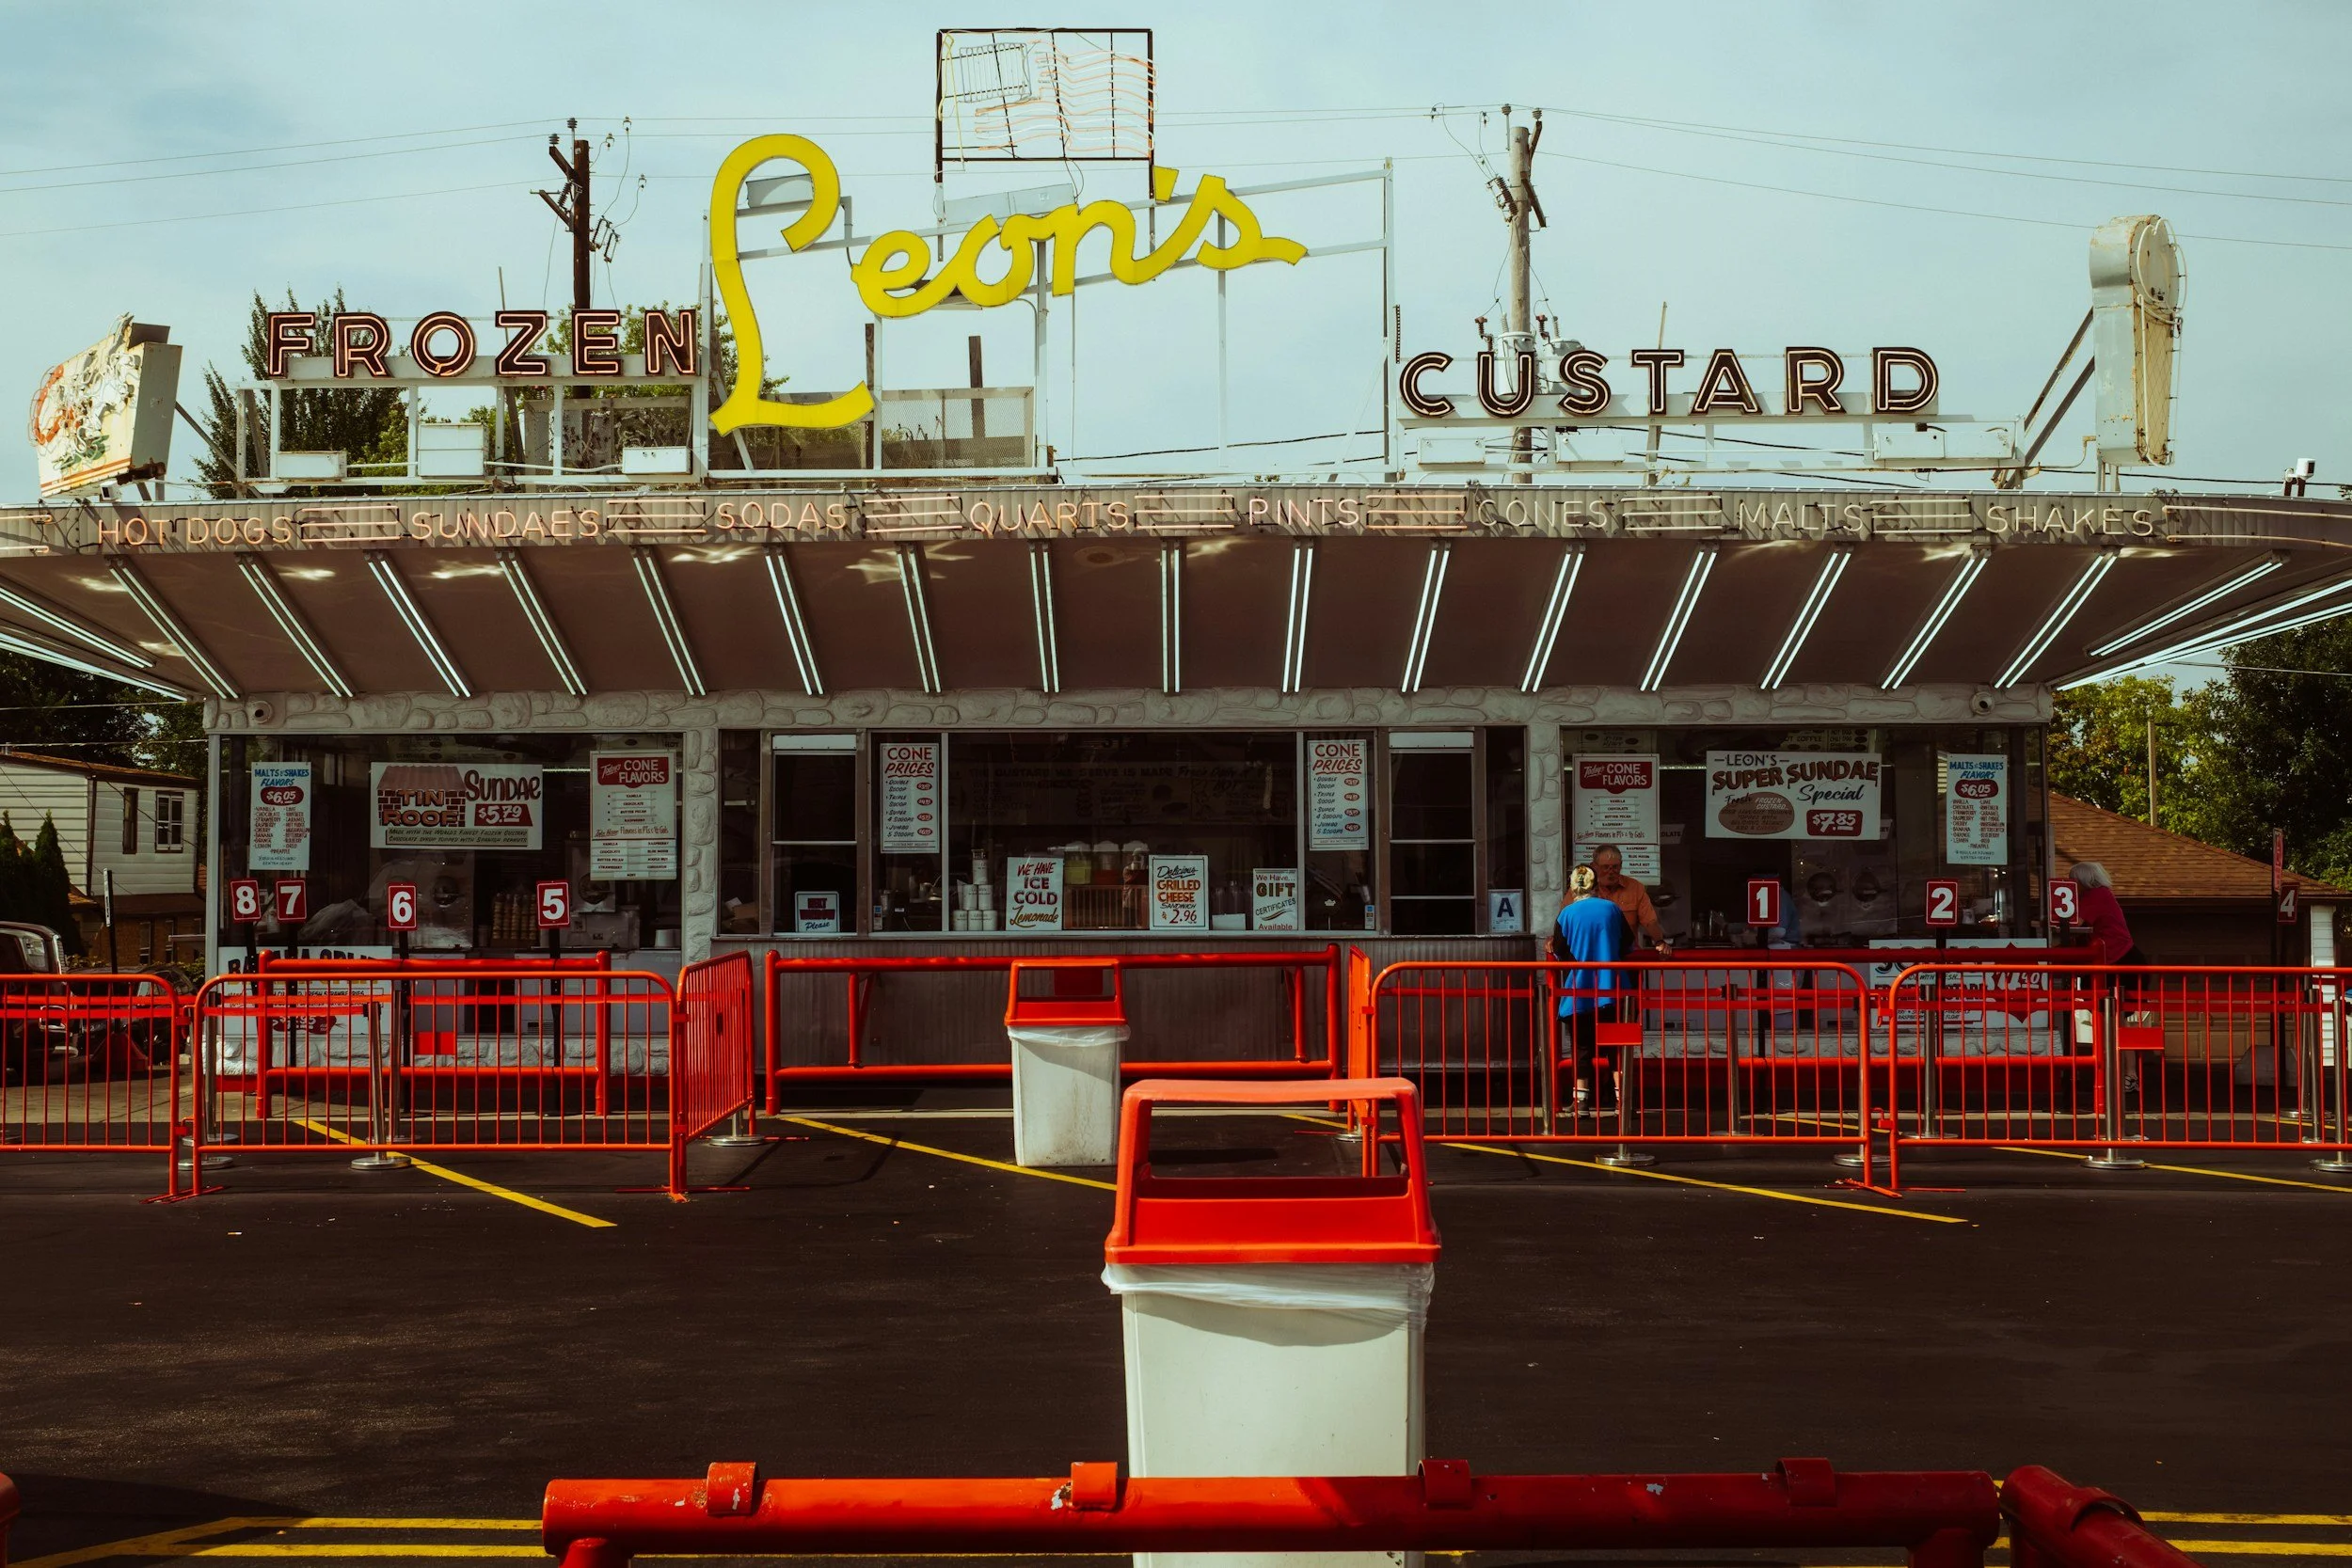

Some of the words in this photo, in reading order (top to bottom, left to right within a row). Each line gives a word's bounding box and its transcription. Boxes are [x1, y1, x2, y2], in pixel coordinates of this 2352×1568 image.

[708, 134, 1308, 436] Leon's
[267, 309, 697, 377] FROZEN
[1399, 346, 1938, 415] CUSTARD
[717, 499, 849, 531] SODAS
[969, 499, 1128, 540] QUARTS
[1248, 498, 1359, 529] PINTS
[1479, 500, 1608, 529] CONES
[1740, 501, 1863, 531] MALTS
[1987, 505, 2153, 535] SHAKES
[98, 518, 170, 545] HOT
[189, 515, 293, 545] DOGS
[411, 509, 599, 539] SUNDAES
[887, 747, 932, 761] CONE
[1315, 744, 1359, 757] CONE
[1725, 753, 1776, 767] LEON'S
[624, 760, 659, 771] CONE
[884, 762, 934, 774] PRICES
[1312, 759, 1362, 771] PRICES
[1606, 763, 1642, 775] CONE
[1949, 762, 1974, 770] MALTS
[1979, 762, 2004, 770] SHAKES
[1961, 770, 1995, 779] FLAVORS
[618, 771, 666, 784] FLAVORS
[1602, 774, 1646, 785] FLAVORS
[1712, 767, 1784, 795] SUPER
[1787, 760, 1879, 788] SUNDAE
[266, 790, 297, 804] $6.05
[397, 790, 444, 807] TIN
[1798, 784, 1865, 805] Special
[1961, 784, 1991, 798] $6.05
[382, 809, 460, 827] ROOF
[478, 805, 522, 825] $5.79
[1812, 812, 1856, 833] $7.85
[1018, 863, 1035, 877] WE
[1034, 862, 1056, 876] HAVE
[1157, 864, 1199, 879] Delicious
[1024, 877, 1050, 890] ICE
[1156, 879, 1201, 892] GRILLED
[1256, 882, 1296, 897] GIFT
[235, 885, 257, 915] 8
[279, 885, 302, 915] 7
[391, 891, 413, 923] 6
[542, 888, 565, 920] 5
[1013, 889, 1057, 906] COLD
[1157, 892, 1196, 903] CHEESE
[1255, 897, 1296, 916] CERTIFICATES
[1756, 887, 1768, 919] 1
[1931, 888, 1954, 919] 2
[2055, 887, 2075, 919] 3
[2280, 889, 2296, 918] 4
[1009, 905, 1059, 928] Lemonade
[1497, 897, 1515, 918] A
[805, 921, 831, 931] Please
[1259, 923, 1293, 931] Available
